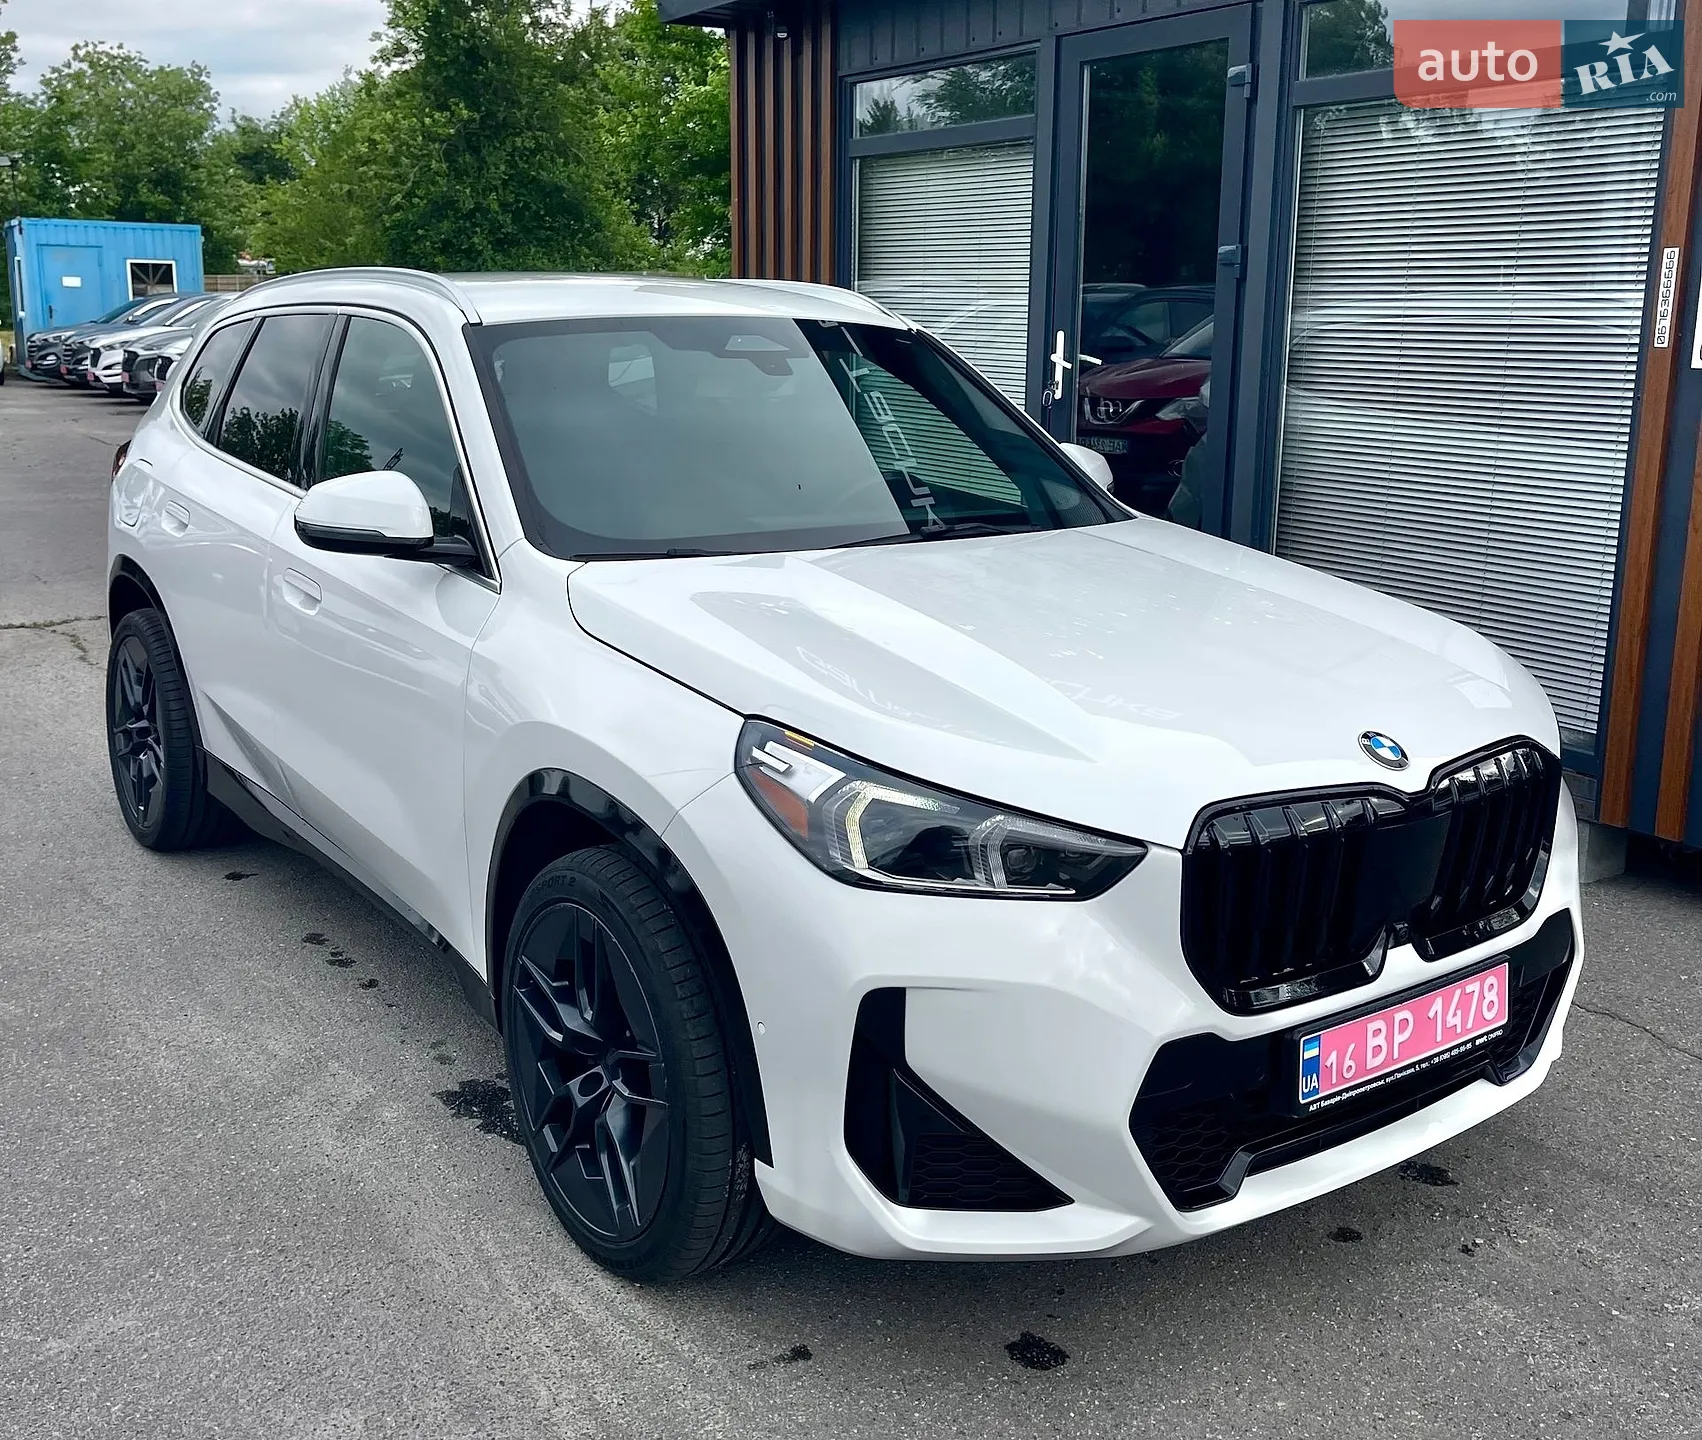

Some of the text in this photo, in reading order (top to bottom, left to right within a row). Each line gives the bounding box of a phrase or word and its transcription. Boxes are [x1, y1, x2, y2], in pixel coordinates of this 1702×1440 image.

[1324, 974, 1499, 1085] 16 BP 1478
[1302, 1072, 1319, 1093] UA
